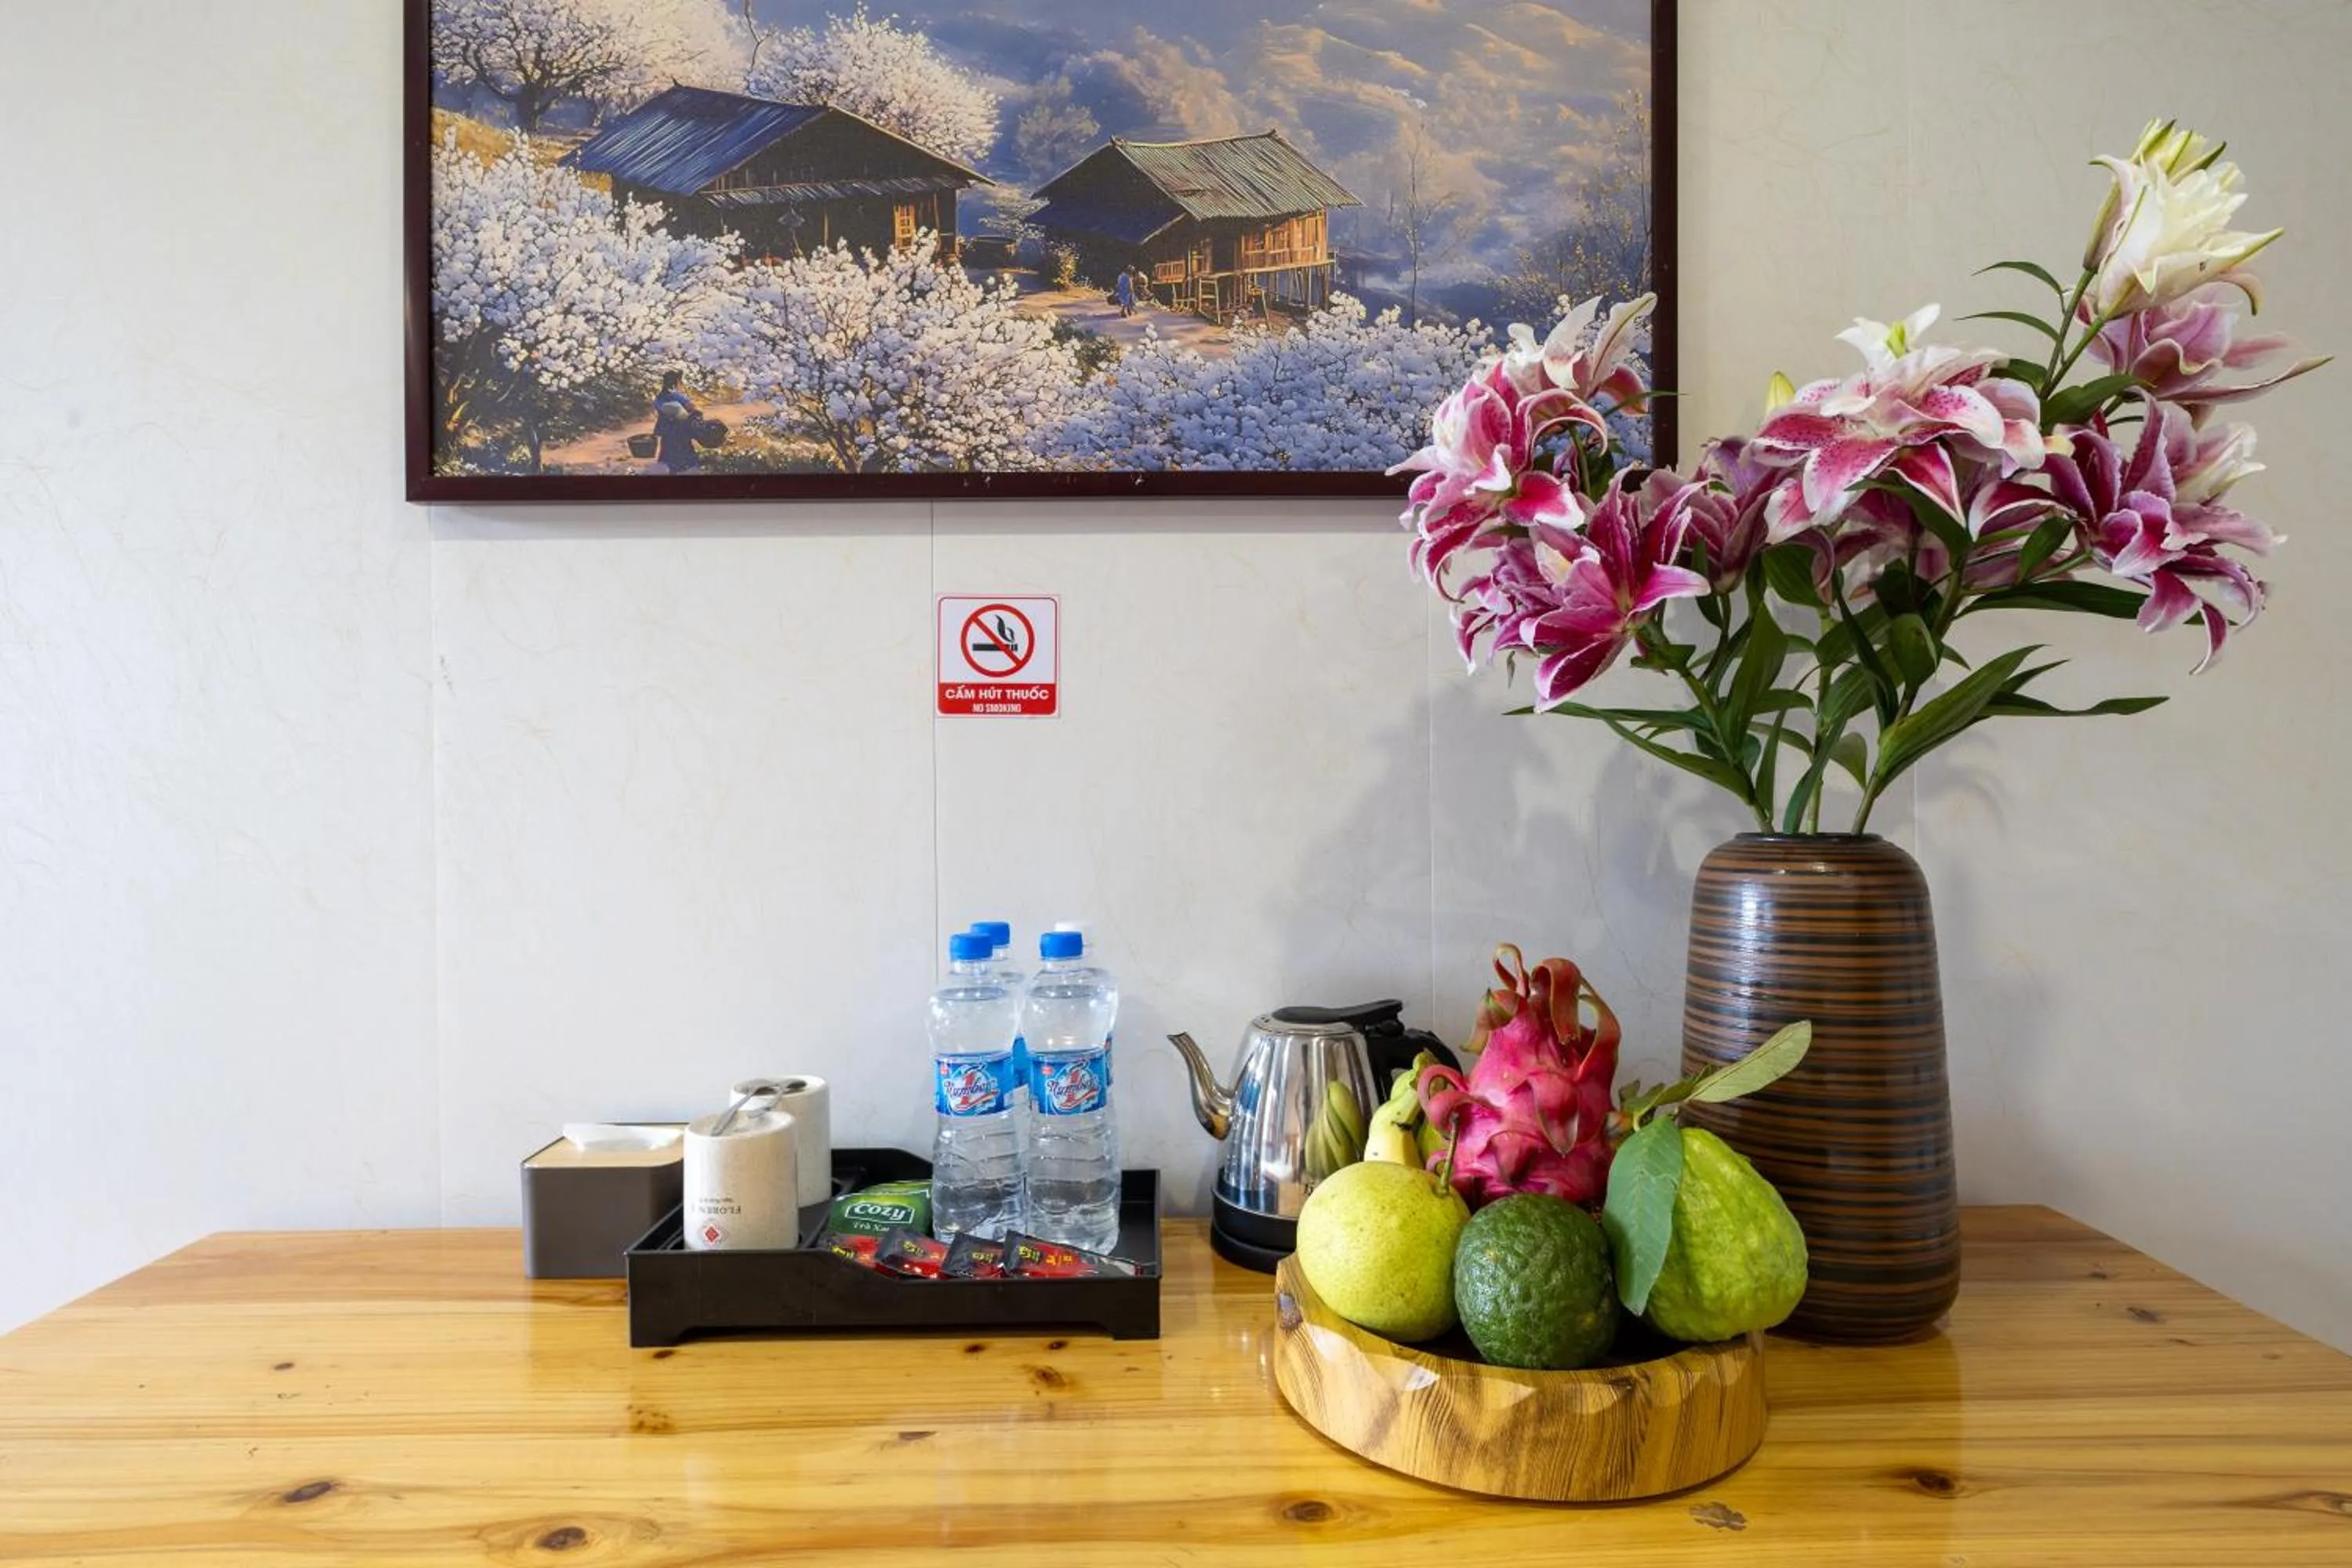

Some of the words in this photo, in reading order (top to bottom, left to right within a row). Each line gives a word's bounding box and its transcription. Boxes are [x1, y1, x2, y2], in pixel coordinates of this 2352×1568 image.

[945, 684, 975, 699] CẤM
[978, 686, 1003, 699] HÚT
[1005, 685, 1050, 700] THUỐC
[973, 703, 984, 713] NO
[985, 703, 1022, 713] SMOKING
